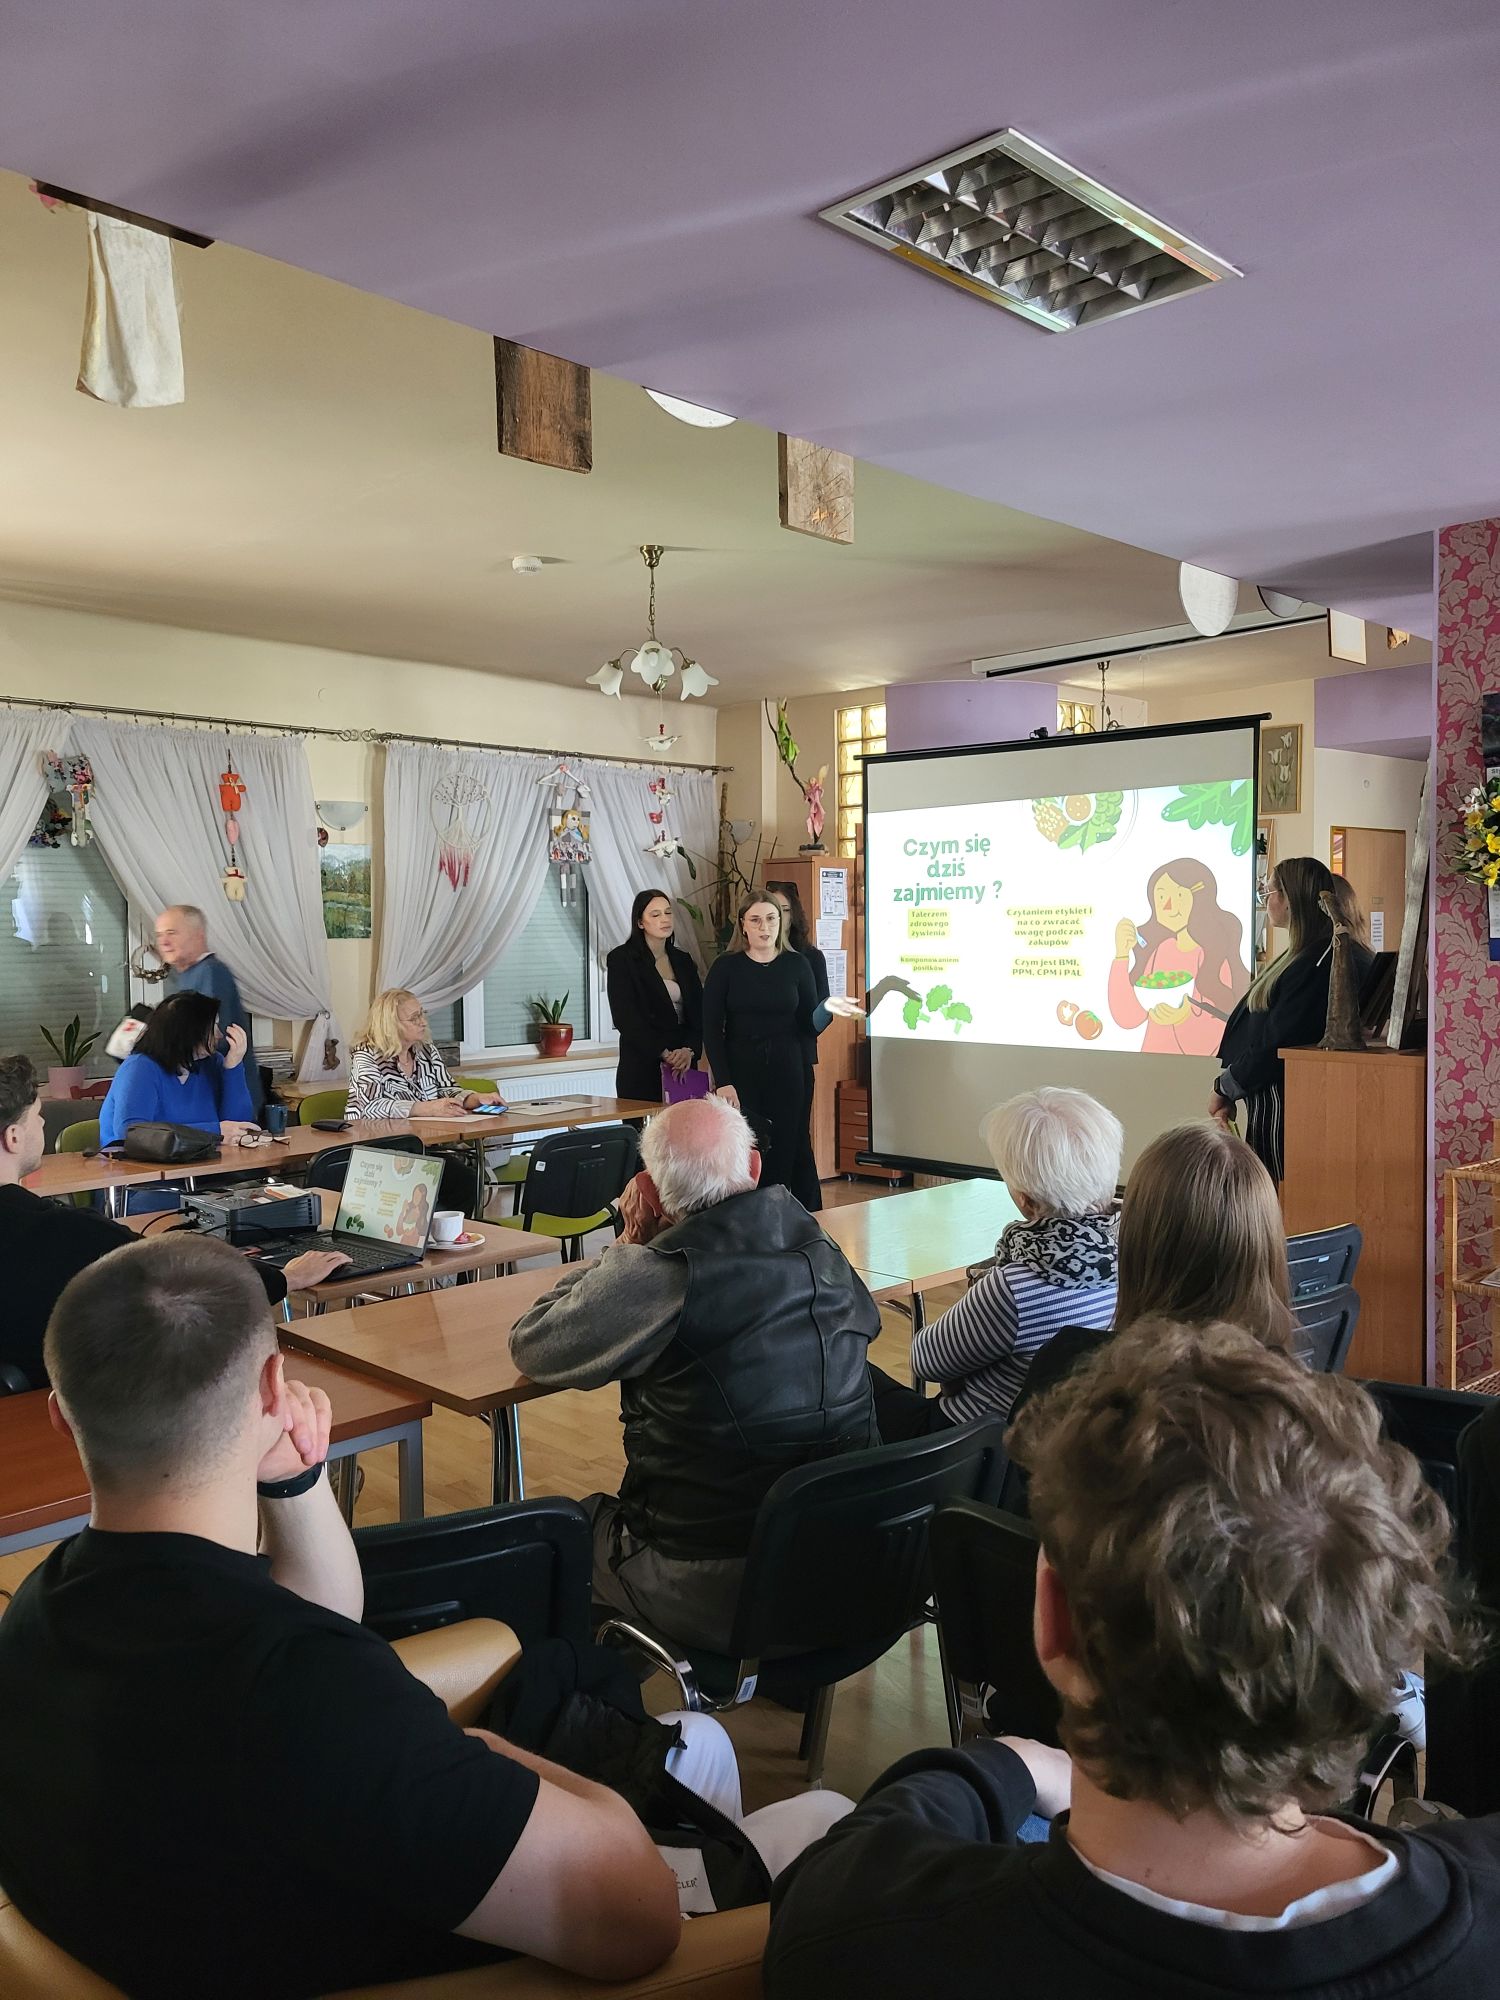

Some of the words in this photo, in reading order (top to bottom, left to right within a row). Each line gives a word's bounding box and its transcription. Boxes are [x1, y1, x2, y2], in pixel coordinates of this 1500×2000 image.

[903, 838, 959, 860] Czym
[965, 833, 991, 856] się
[927, 857, 966, 878] dziś
[893, 882, 986, 907] zajmiemy
[992, 880, 1003, 899] ?
[1006, 908, 1053, 917] Czytaniem
[1055, 907, 1087, 916] etykiet
[1046, 928, 1084, 937] podczas
[1028, 938, 1069, 947] zakupów
[1014, 958, 1039, 967] Czym
[1040, 958, 1057, 967] jest
[1037, 968, 1057, 976] CPM
